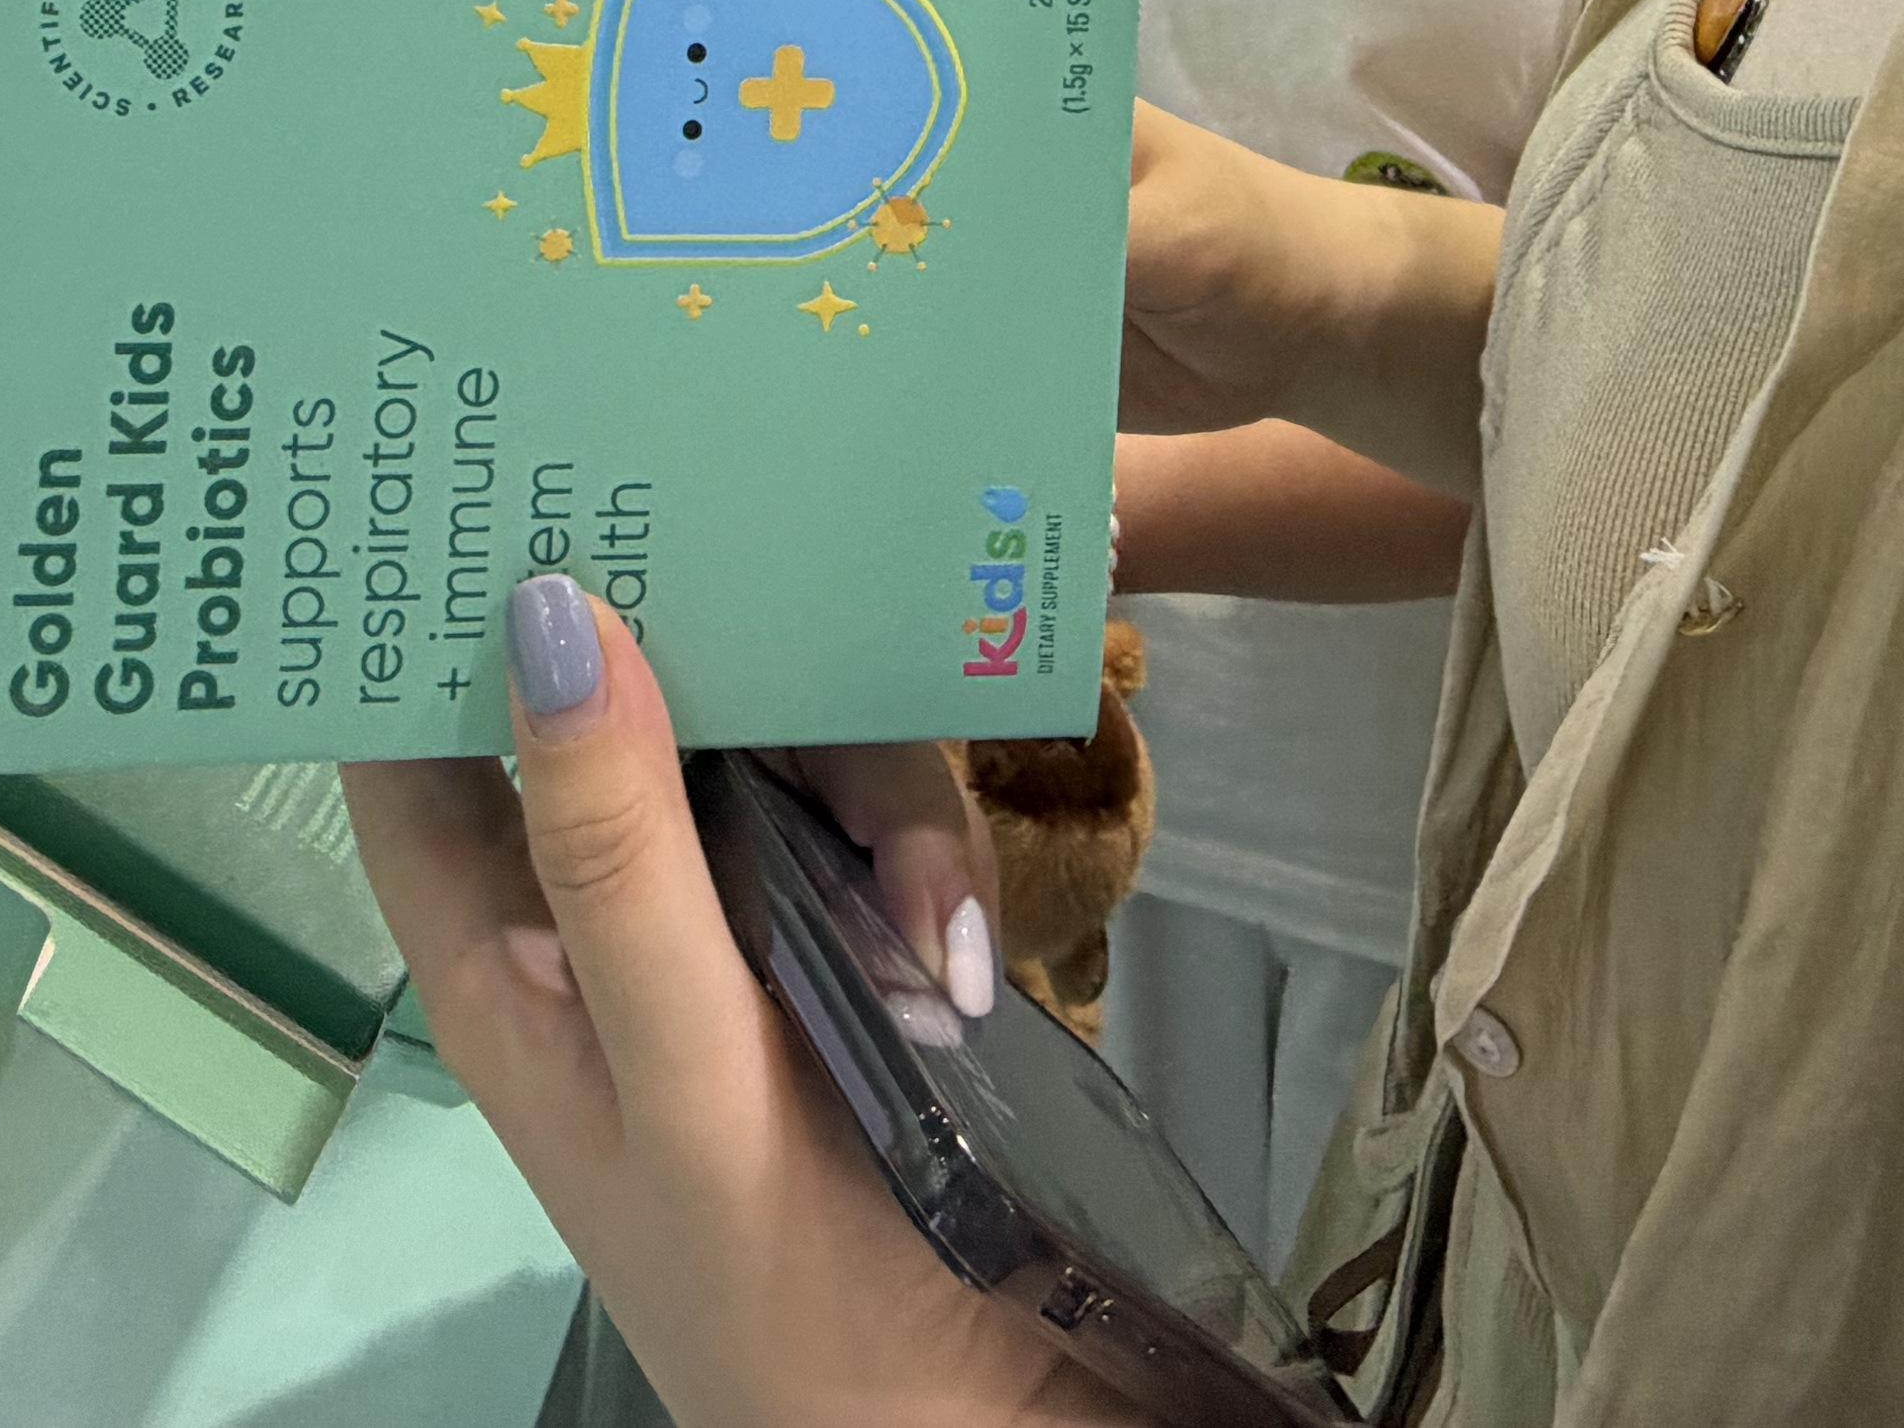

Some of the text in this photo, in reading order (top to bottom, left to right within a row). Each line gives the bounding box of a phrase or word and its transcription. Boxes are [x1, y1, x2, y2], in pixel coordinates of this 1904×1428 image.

[1061, 63, 1093, 114] (1.5g
[1066, 12, 1090, 34] 15
[10, 448, 83, 718] Golden
[97, 301, 176, 715] Guard Kids
[179, 344, 256, 711] Probiotics
[278, 397, 339, 708] supports
[360, 329, 435, 704] respiratory
[429, 366, 500, 701] + immune
[591, 483, 652, 645] alth
[1038, 514, 1063, 674] DIETARY SUPPLEMENT
